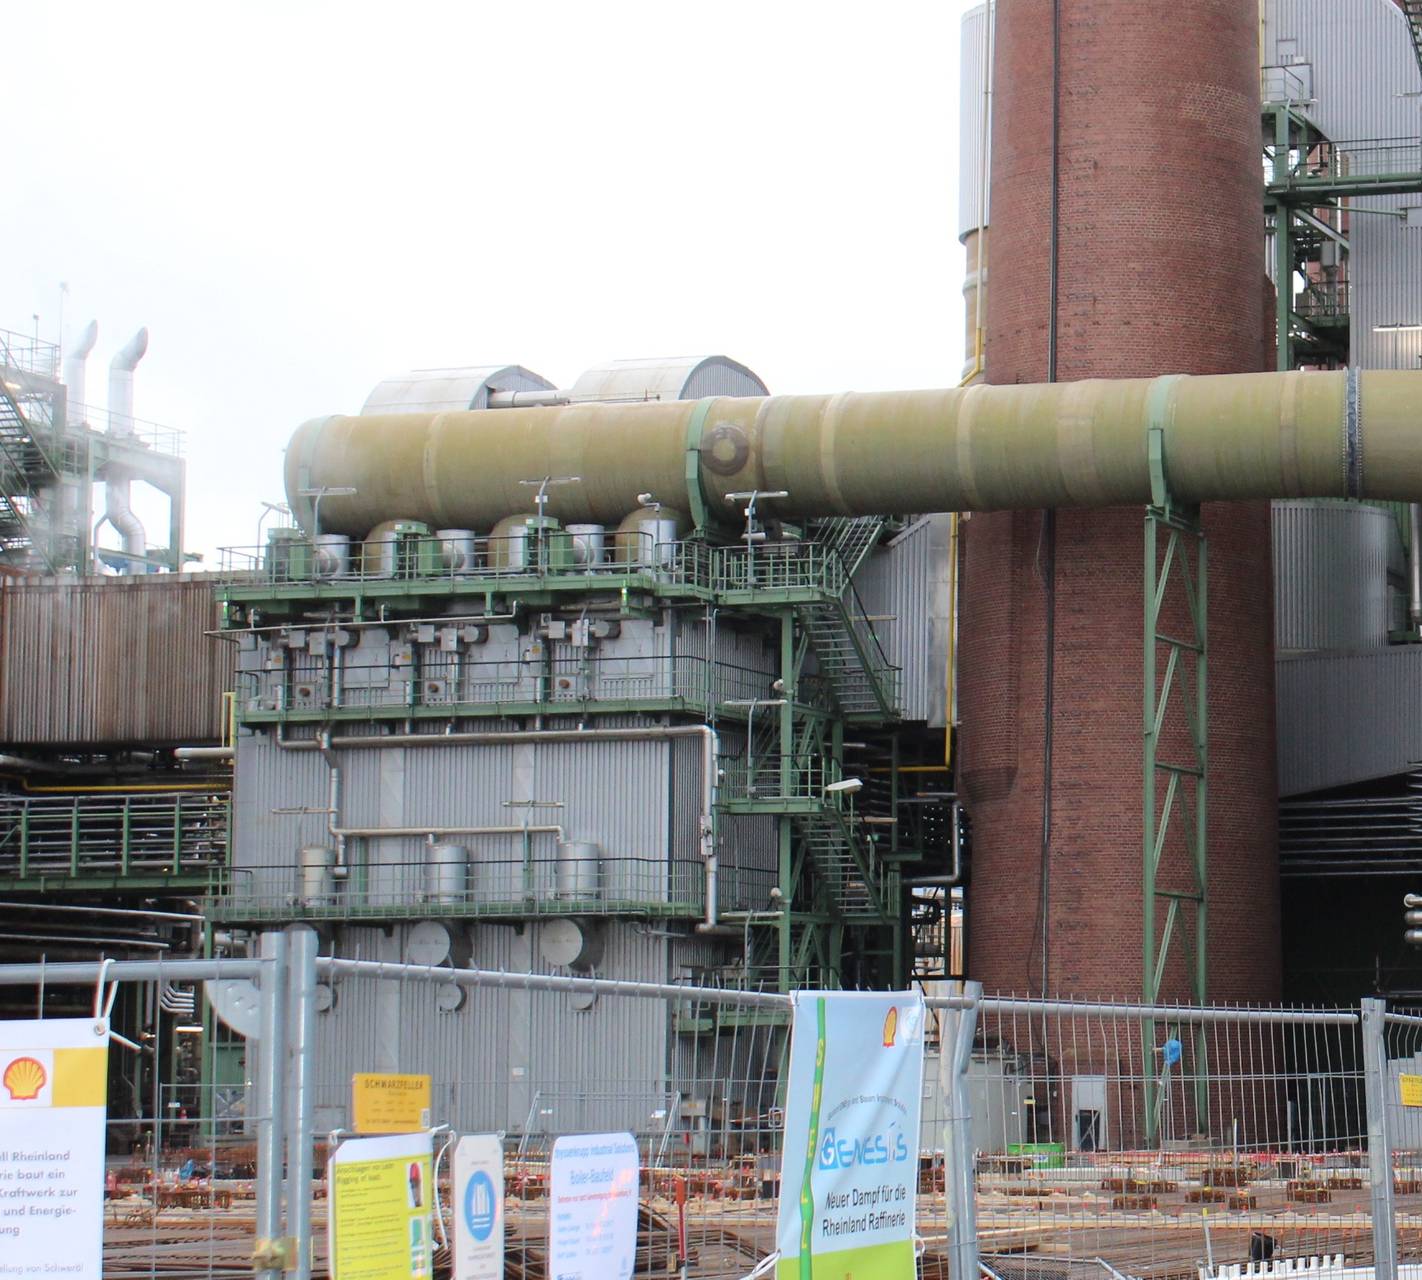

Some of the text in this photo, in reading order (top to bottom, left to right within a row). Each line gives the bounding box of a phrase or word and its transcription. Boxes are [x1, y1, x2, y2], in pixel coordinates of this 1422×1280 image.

[12, 1150, 71, 1161] Rheinland
[17, 1168, 45, 1180] baut
[48, 1168, 66, 1180] ein
[60, 1188, 78, 1198] zur
[825, 1183, 906, 1210] Neuer Dampf für die
[3, 1205, 26, 1216] und
[822, 1209, 906, 1237] Rheinland Raffinerie
